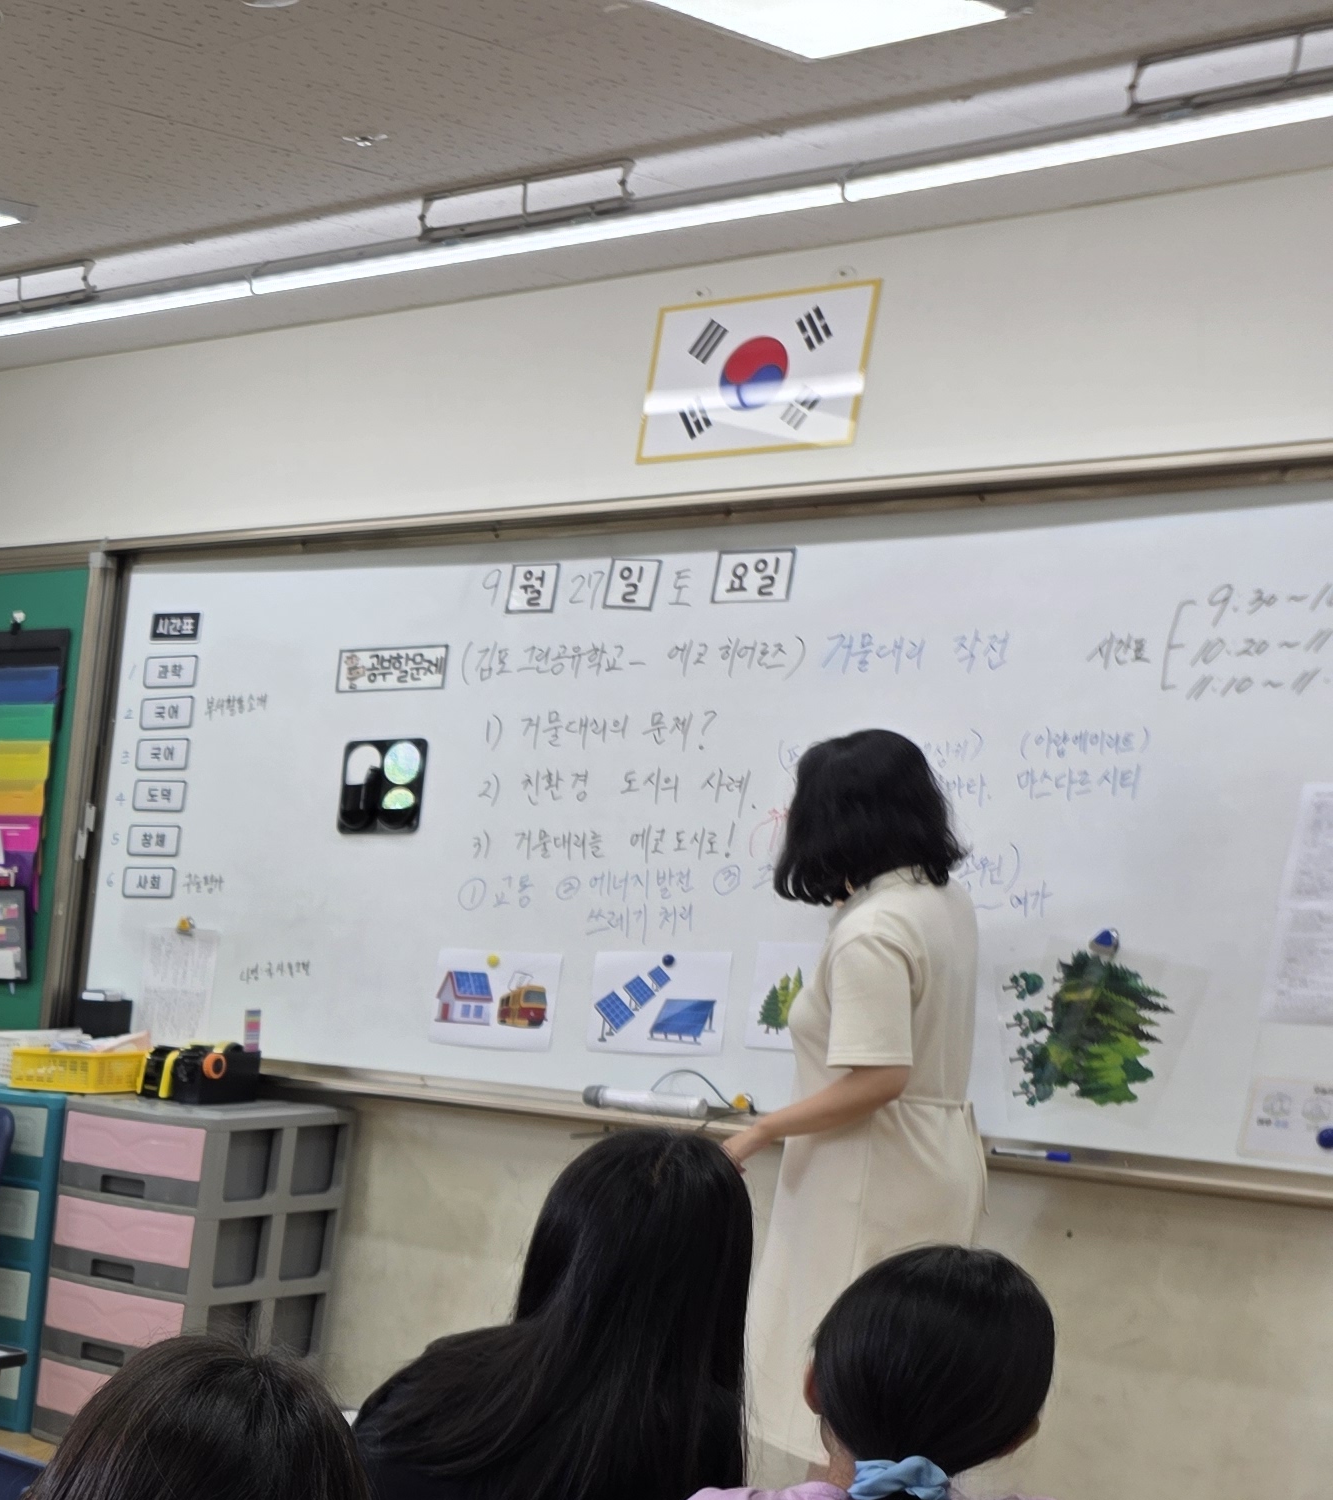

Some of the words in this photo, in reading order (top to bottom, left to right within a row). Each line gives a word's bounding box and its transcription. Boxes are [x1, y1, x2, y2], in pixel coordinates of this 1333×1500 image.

[482, 568, 502, 606] 9
[521, 569, 546, 606] 월
[569, 570, 606, 610] 27
[621, 565, 642, 603] 일
[668, 569, 693, 606] 토
[725, 557, 780, 597] 요일
[156, 616, 195, 636] 시간표
[667, 644, 705, 676] 에코
[820, 632, 925, 675] 거물대리
[953, 628, 1010, 675] 작전
[157, 663, 184, 679] 과학
[154, 704, 179, 720] 국어
[485, 713, 503, 751] 1)
[521, 710, 629, 750] 거물대리의
[642, 710, 718, 752] 문제?
[150, 746, 175, 762] 국어
[115, 792, 126, 807] 4
[146, 787, 172, 803] 도덕
[477, 773, 500, 807] 2)
[521, 767, 589, 806] 친환경
[620, 766, 679, 805] 도시의
[1098, 763, 1142, 800] 시티
[110, 832, 120, 846] 5
[473, 830, 490, 859] 3)
[515, 828, 605, 861] 거물대리를
[630, 824, 665, 864] 에코
[106, 872, 115, 888] 6
[136, 873, 161, 890] 사회
[589, 868, 650, 903] 에너지
[656, 867, 694, 899] 발전
[586, 903, 649, 945] 쓰레기
[658, 902, 694, 937] 처리
